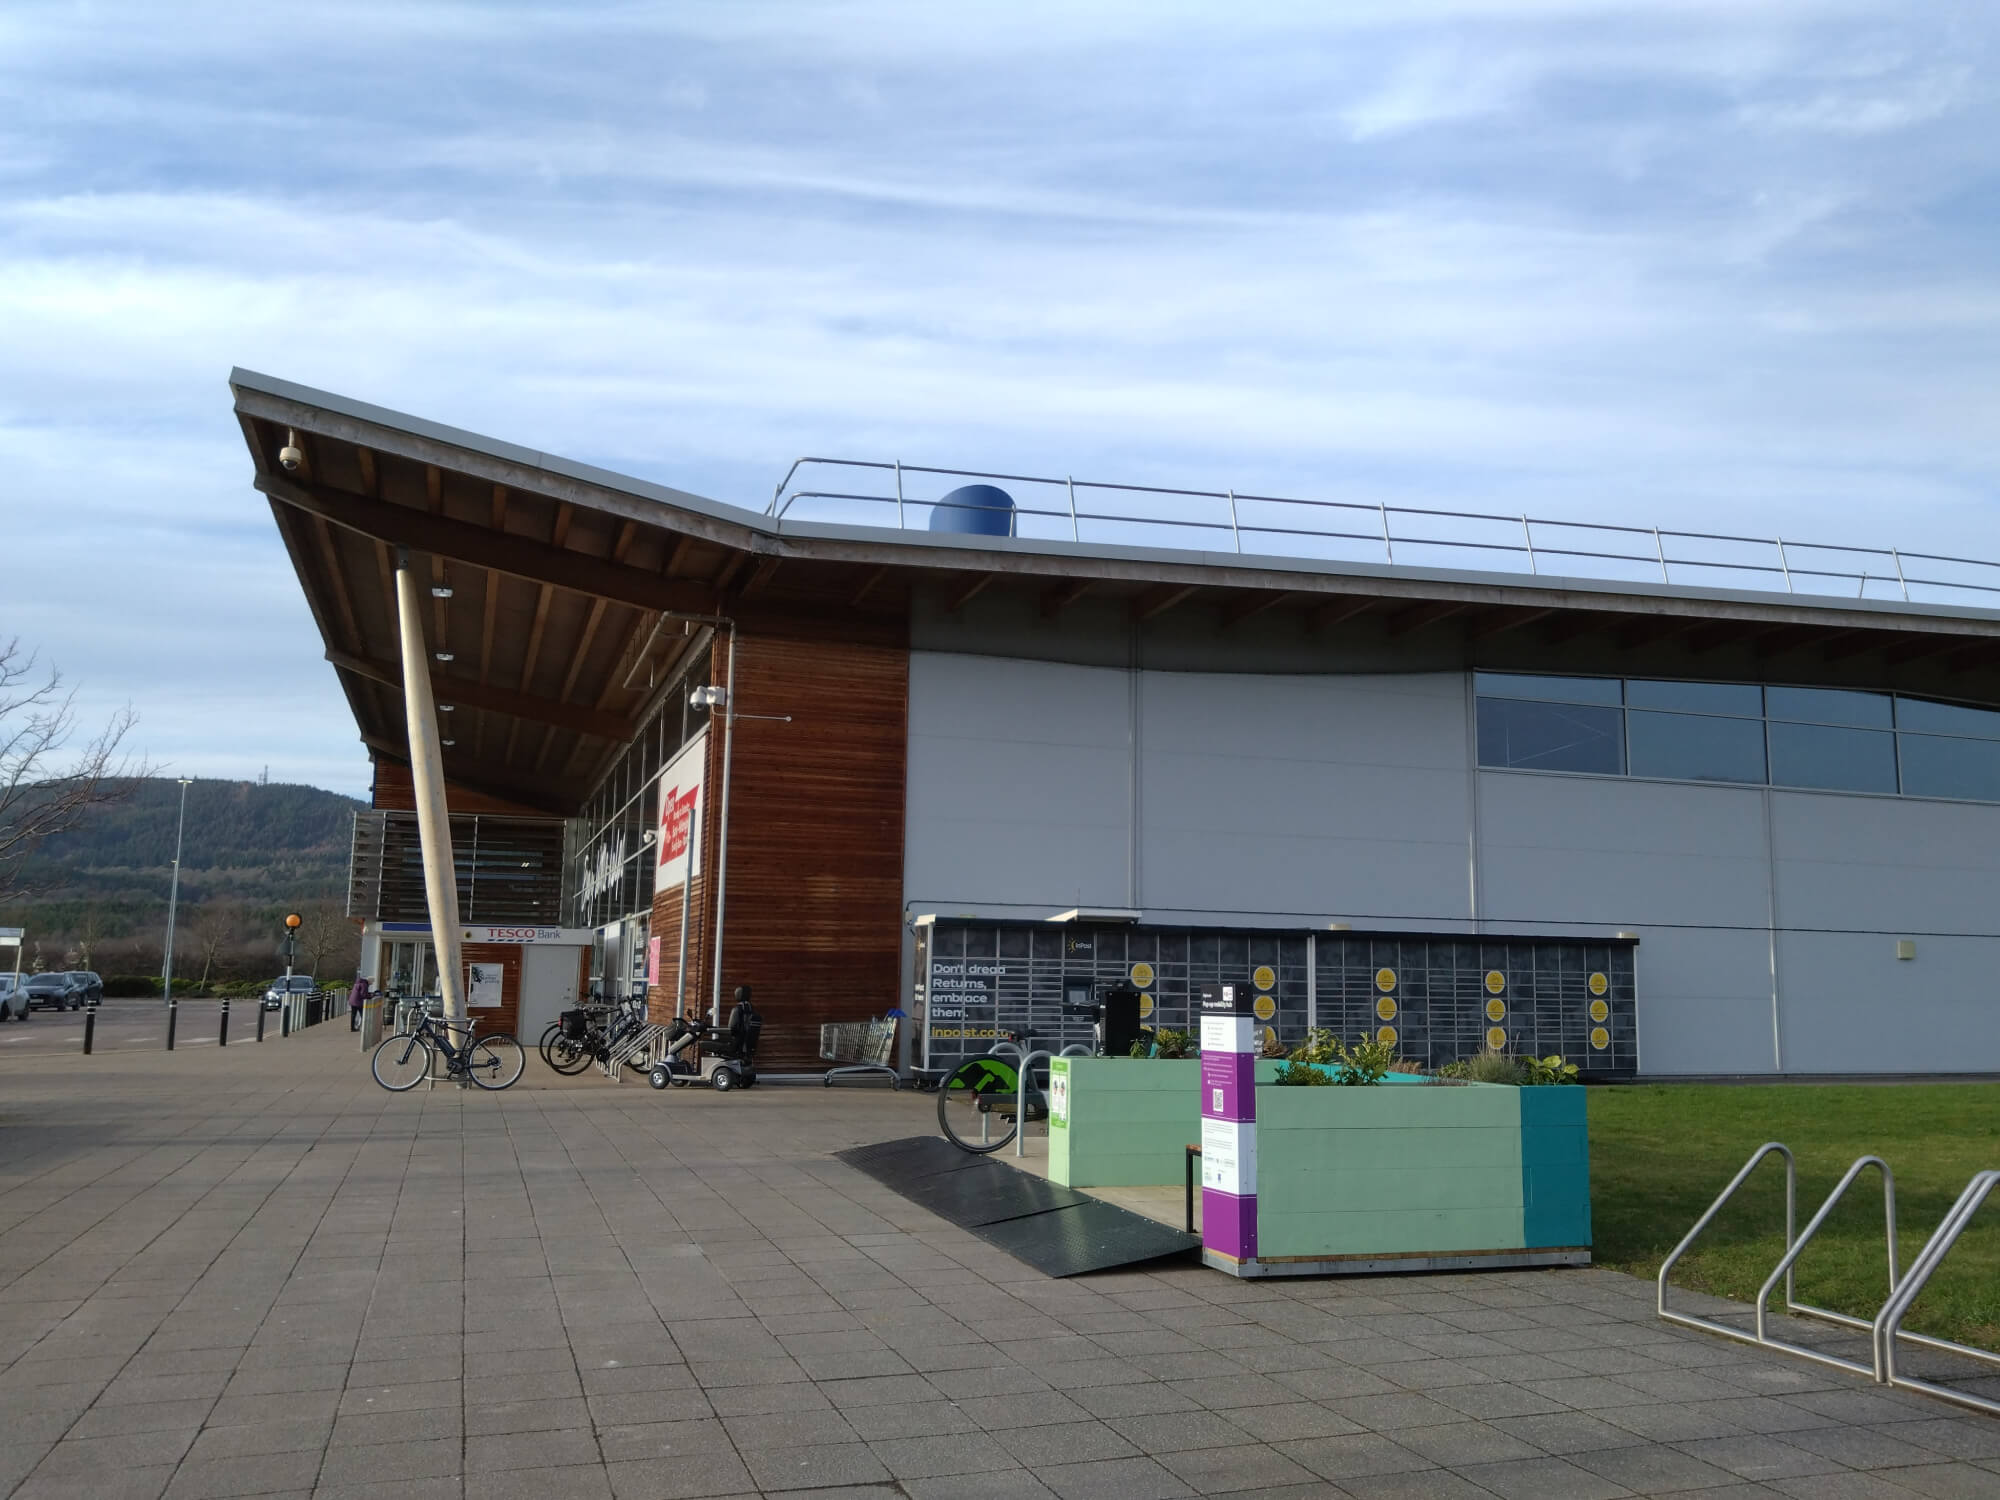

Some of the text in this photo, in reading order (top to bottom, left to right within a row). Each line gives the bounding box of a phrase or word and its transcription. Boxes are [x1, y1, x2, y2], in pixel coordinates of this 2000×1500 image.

[487, 928, 560, 939] TESCO Bank
[1075, 942, 1092, 950] InPost
[933, 963, 1006, 975] Don't dread
[933, 978, 987, 990] Returns,
[932, 993, 988, 1003] embrace
[932, 1008, 969, 1018] them.
[931, 1026, 1010, 1038] inpost.co.u
